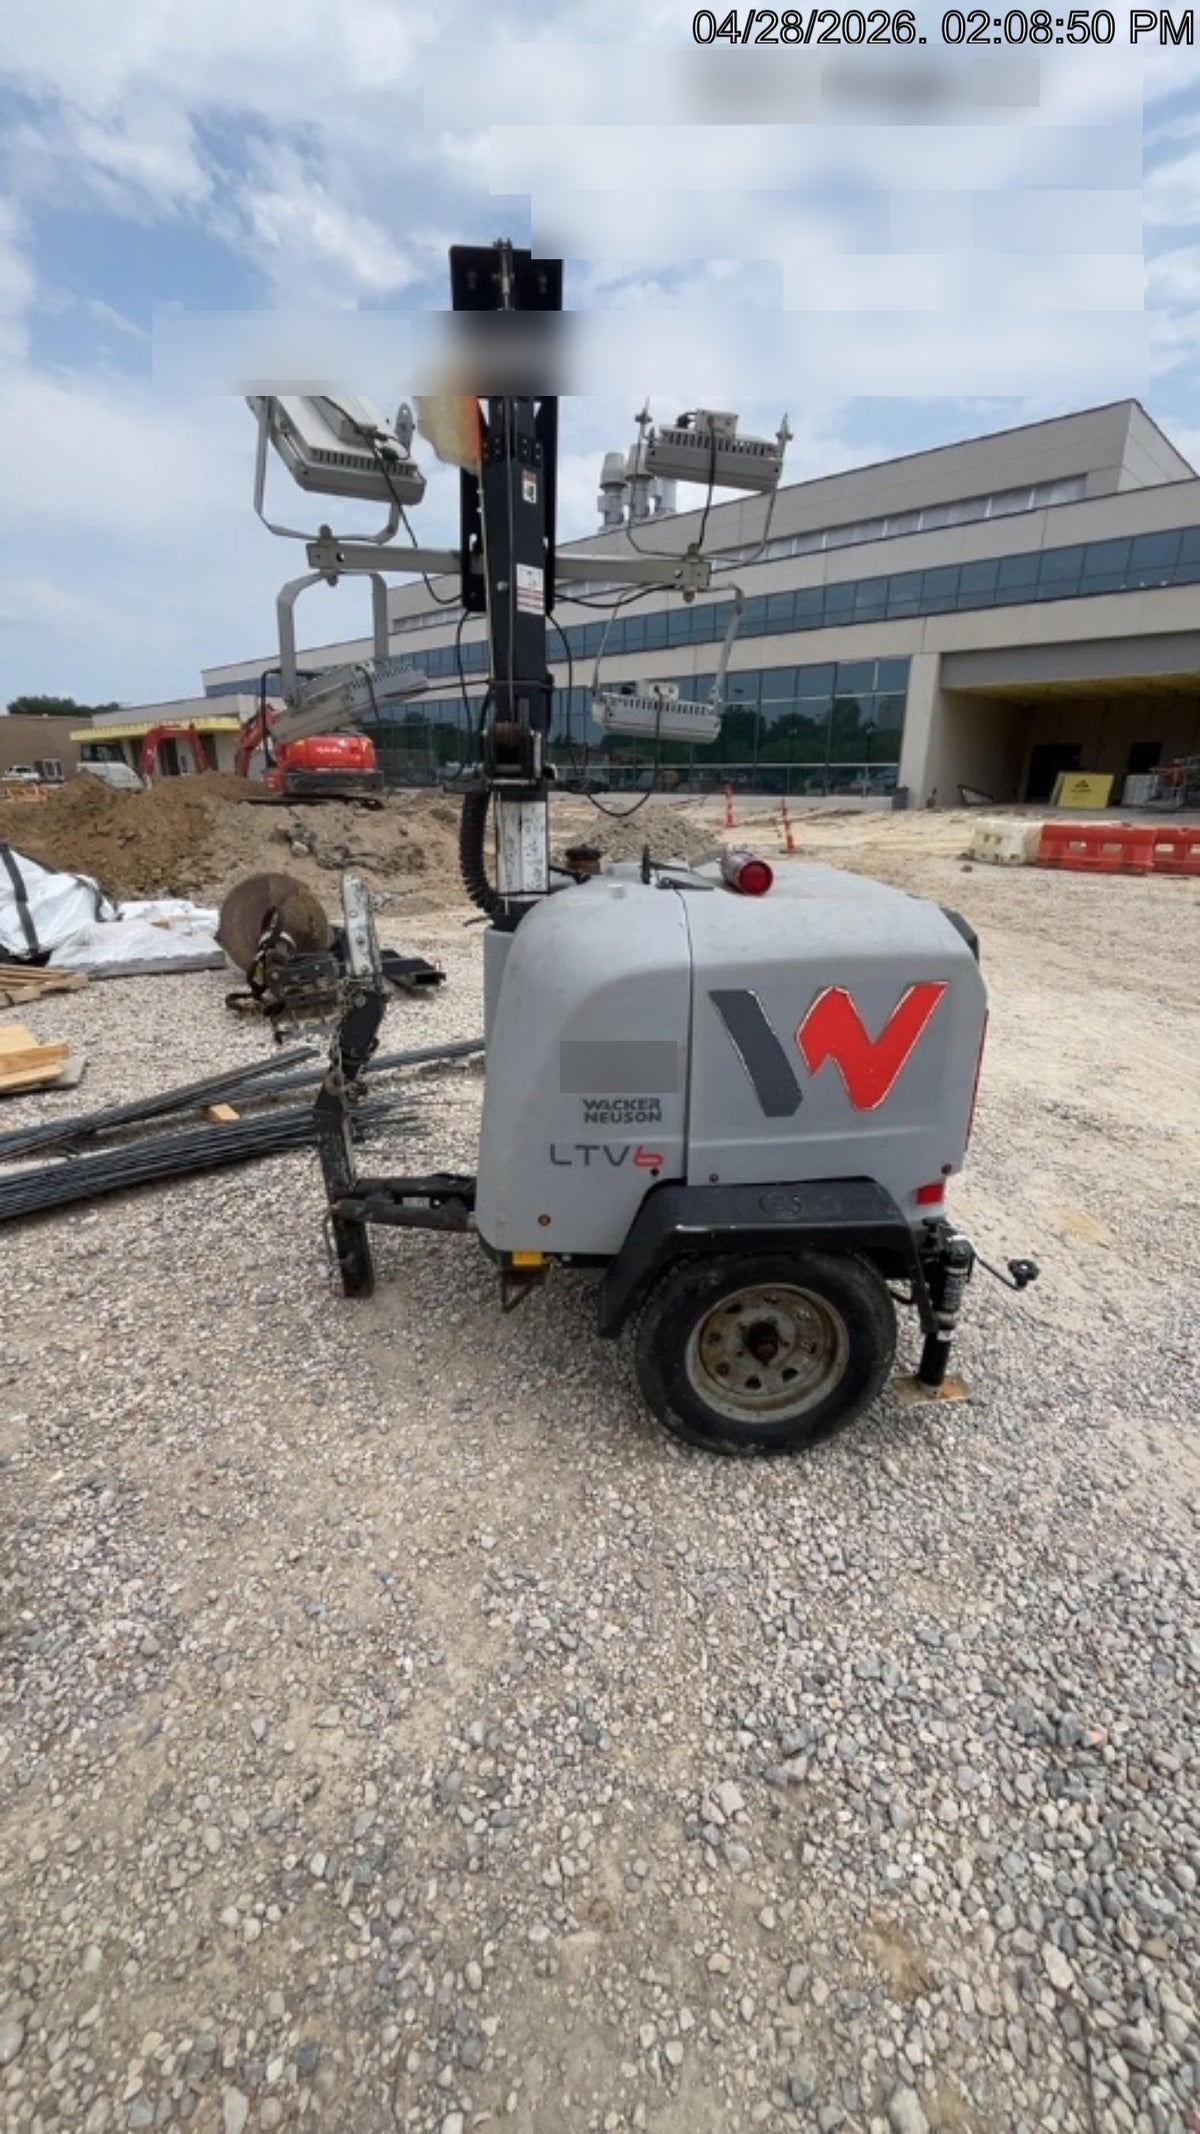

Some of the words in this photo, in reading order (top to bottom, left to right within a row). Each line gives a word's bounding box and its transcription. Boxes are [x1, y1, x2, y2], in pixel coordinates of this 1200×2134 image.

[583, 1098, 661, 1111] WACKER
[585, 1111, 662, 1124] NEUSON
[550, 1143, 664, 1167] LTV6
